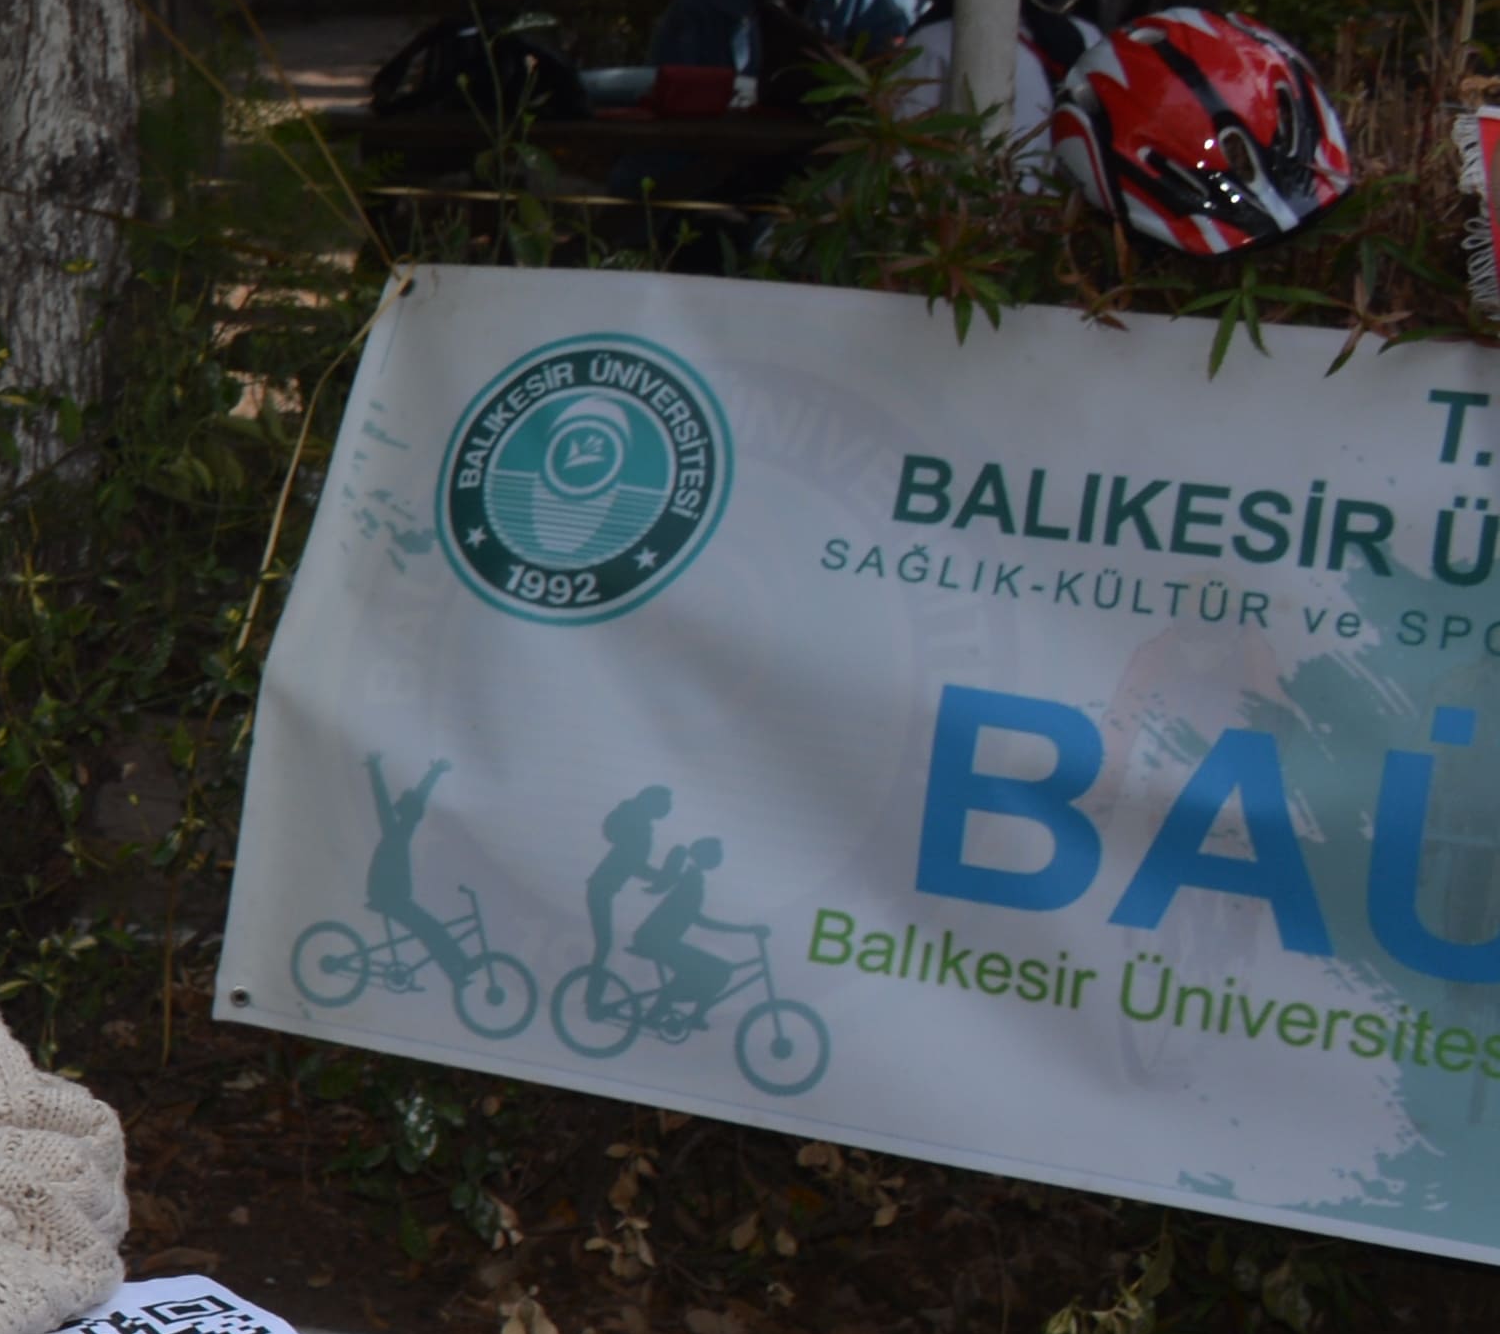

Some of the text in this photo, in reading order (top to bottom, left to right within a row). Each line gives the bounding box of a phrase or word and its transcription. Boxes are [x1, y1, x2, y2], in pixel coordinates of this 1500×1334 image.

[459, 362, 574, 489] BALIKESİR
[590, 354, 706, 520] ÜNİVERSİTESİ
[892, 454, 1396, 579] BALIKESİR
[504, 565, 600, 604] 1992
[820, 538, 1272, 629] SAĞLIK-KÜLTÜR
[1303, 606, 1362, 638] ve
[808, 908, 1096, 1010] Balıkesir
